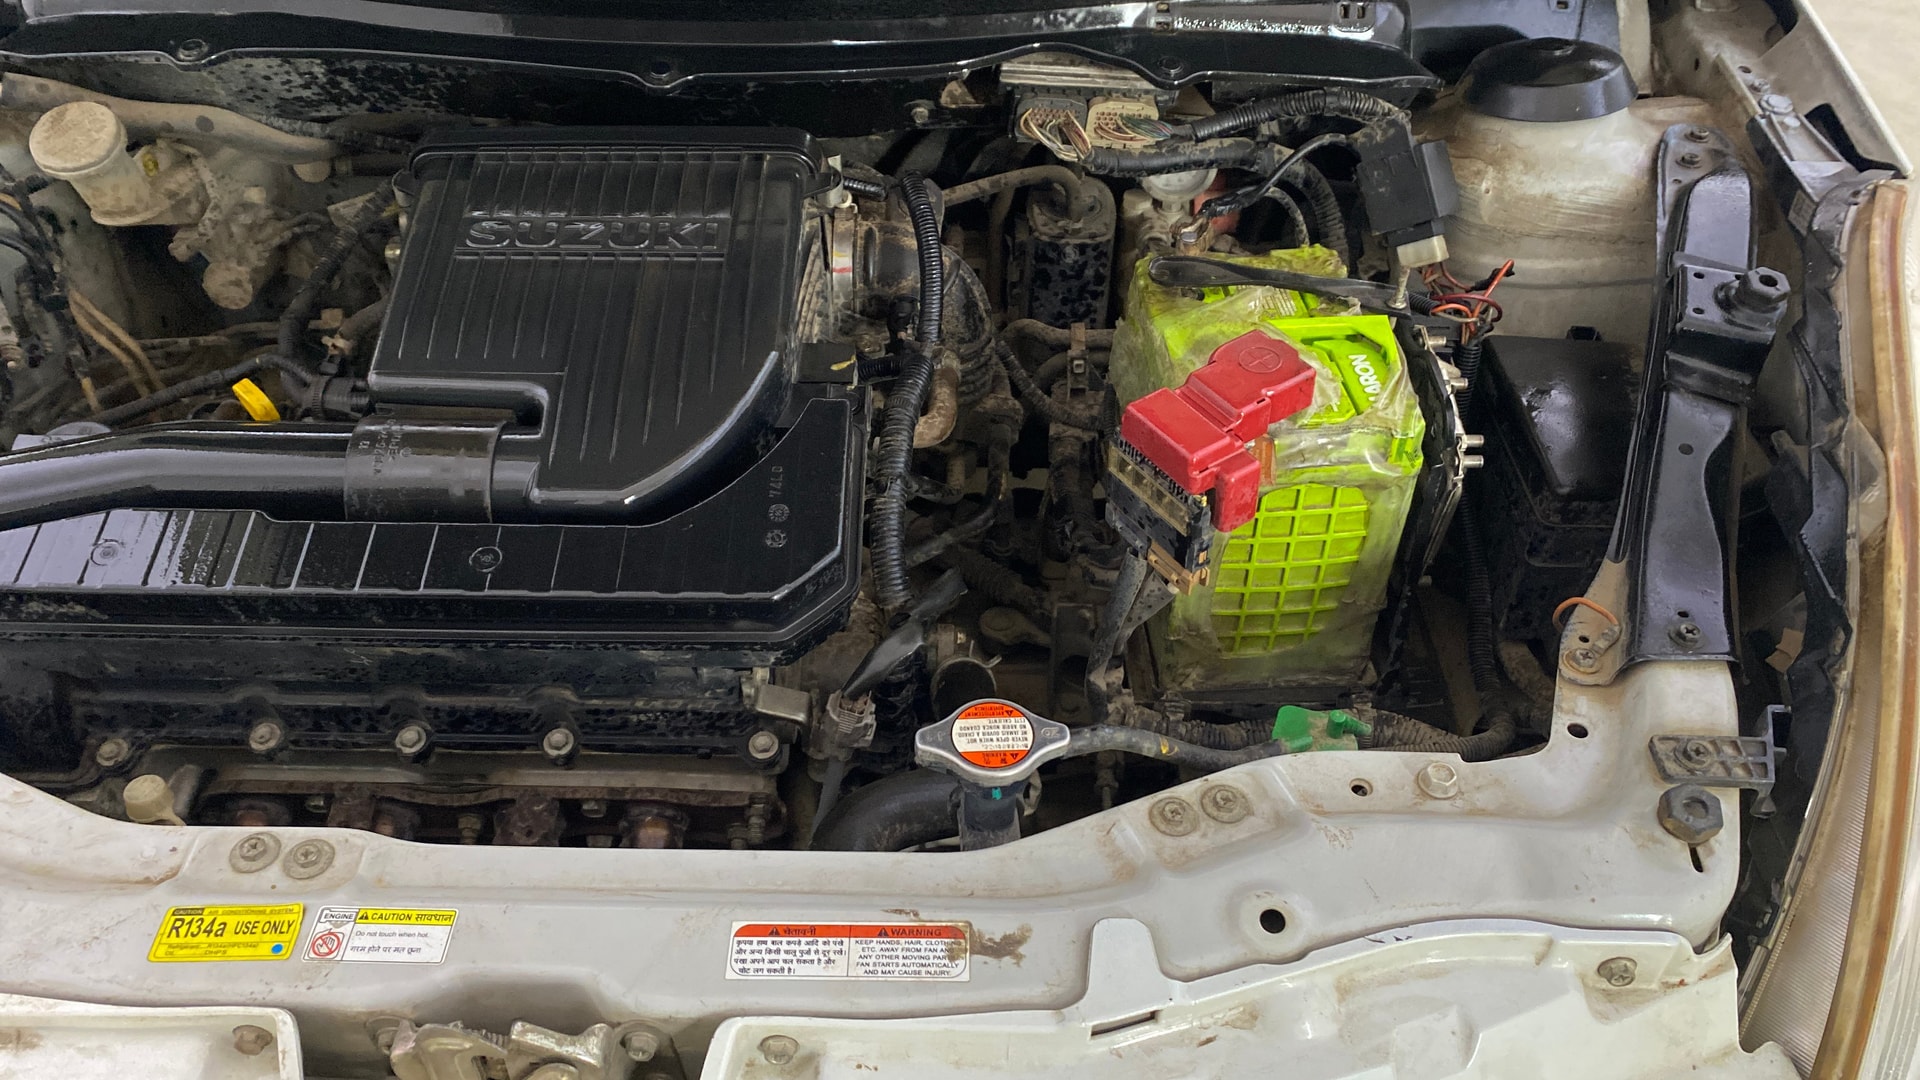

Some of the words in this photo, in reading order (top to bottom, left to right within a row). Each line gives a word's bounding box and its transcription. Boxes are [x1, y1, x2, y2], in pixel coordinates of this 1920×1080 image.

[465, 220, 719, 249] SUZUKI
[371, 913, 412, 921] CAUTION
[415, 913, 453, 922] सावधान
[167, 917, 227, 938] R134a
[234, 921, 260, 935] USE
[262, 920, 295, 935] ONLY
[783, 927, 816, 935] चेतावनी
